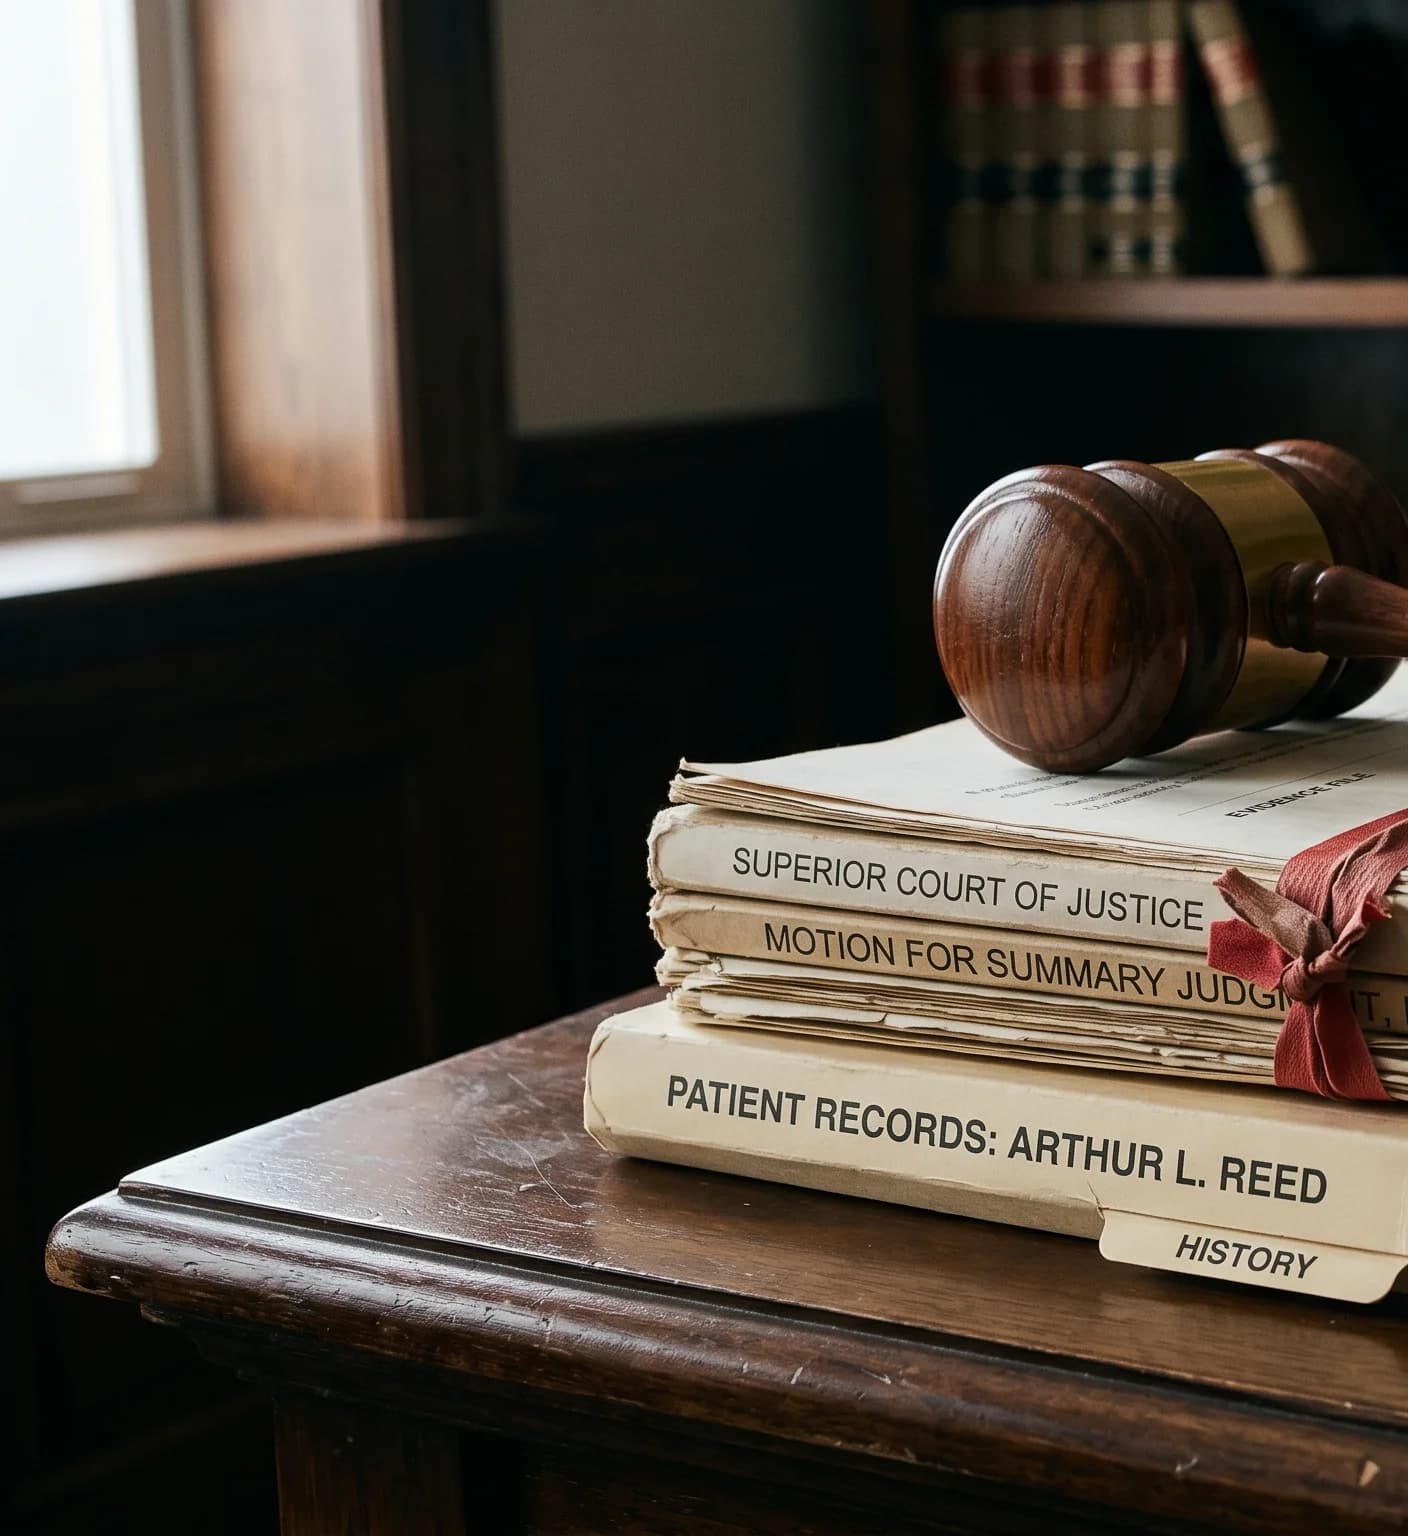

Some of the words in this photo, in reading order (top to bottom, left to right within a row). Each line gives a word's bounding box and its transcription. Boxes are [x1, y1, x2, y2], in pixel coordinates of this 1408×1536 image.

[1226, 787, 1332, 818] EVIDENCE
[1327, 772, 1376, 788] FILE
[733, 847, 886, 892] SUPERIOR
[897, 866, 1005, 906] COURT
[1015, 881, 1059, 911] OF
[1067, 888, 1205, 931] JUSTICE
[764, 923, 896, 965] MOTION
[906, 939, 978, 974] FOR
[987, 949, 1166, 996] SUMMARY
[1177, 971, 1391, 1028] JUDGT,
[667, 1075, 805, 1125] PATIENT
[815, 1097, 997, 1156] RECORDS:
[1008, 1126, 1163, 1179] ARTHUR
[1176, 1150, 1205, 1188] L.
[1220, 1157, 1327, 1204] REED
[1175, 1234, 1318, 1279] HISTORY
